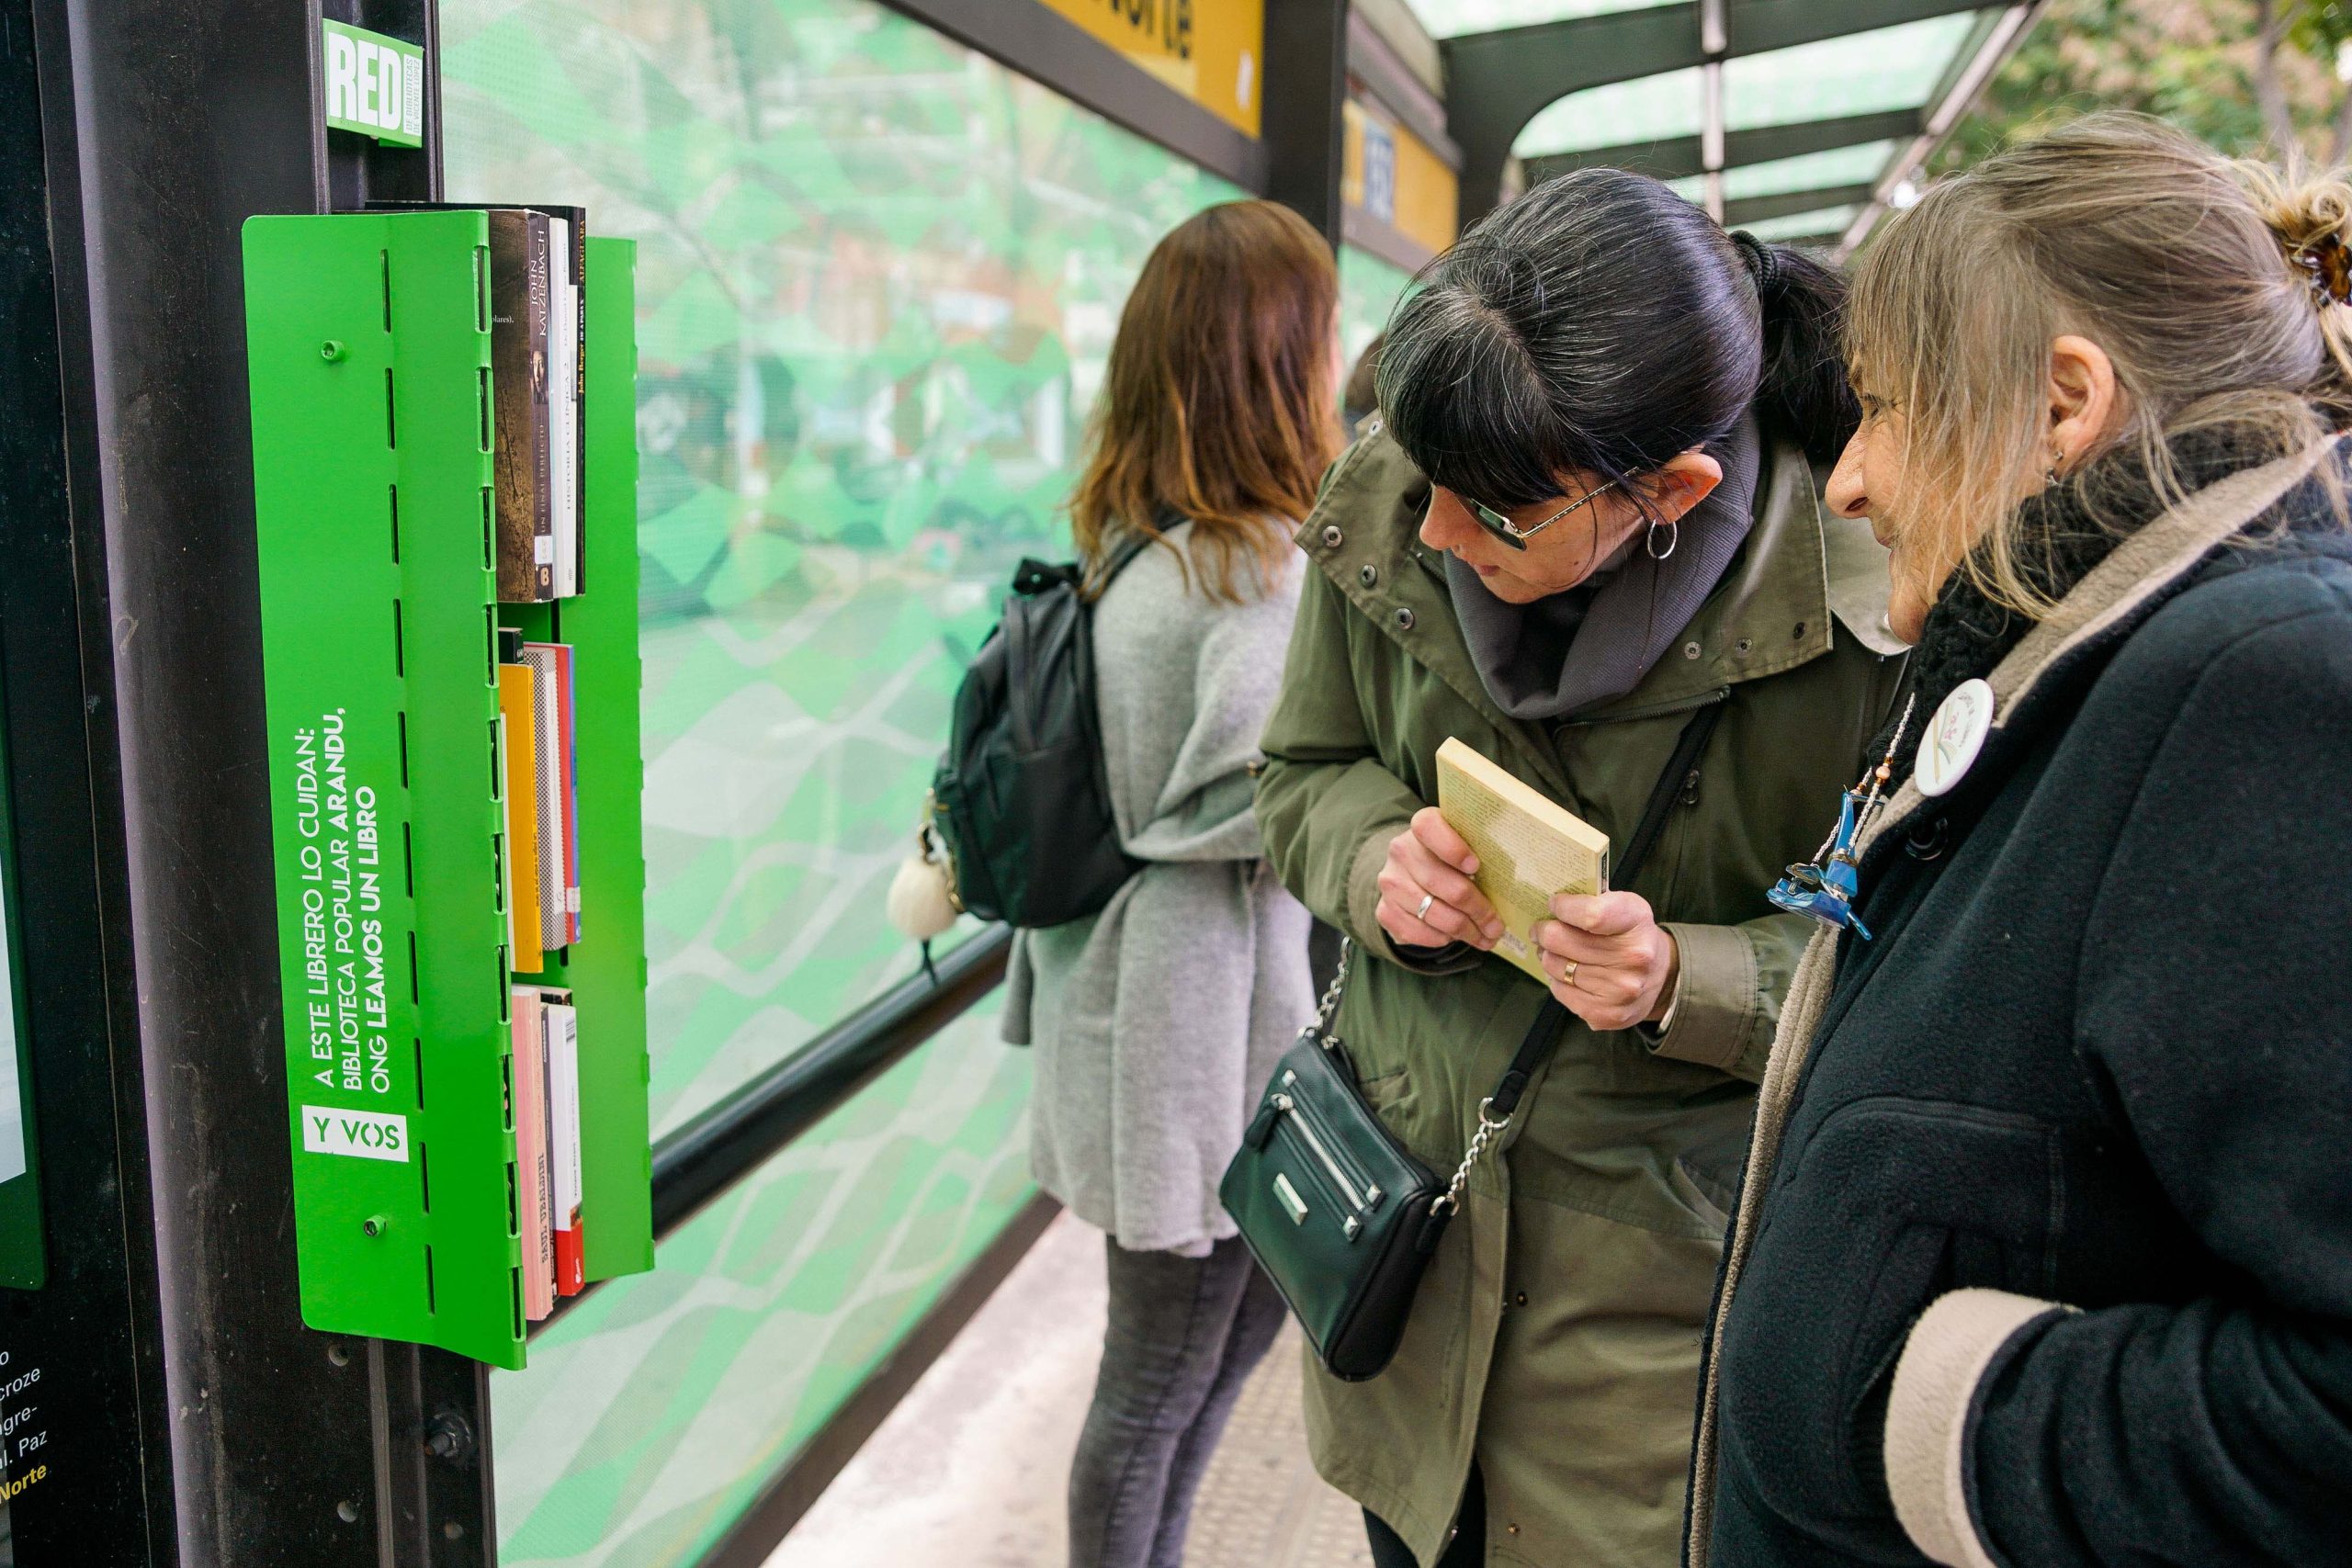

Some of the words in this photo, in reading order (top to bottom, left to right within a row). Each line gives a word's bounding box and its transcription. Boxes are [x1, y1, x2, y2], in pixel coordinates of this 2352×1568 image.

[328, 31, 402, 130] RED
[406, 119, 413, 131] DE
[413, 122, 420, 134] DE
[538, 230, 547, 336] KATZENBACH
[294, 728, 320, 839] CUIDAN:
[322, 707, 350, 832] ARANDU,
[355, 785, 379, 865] LIBRO
[300, 845, 322, 881] LO
[359, 872, 381, 912] UN
[330, 839, 355, 955] POPULAR
[302, 889, 329, 996] LIBRERO
[361, 919, 388, 1029] LEAMOS
[309, 1002, 333, 1061] ESTE
[336, 962, 362, 1091] BIBLIOTECA
[313, 1069, 334, 1089] A
[368, 1035, 390, 1094] ONG
[313, 1116, 331, 1143] Y
[341, 1119, 401, 1150] VOS
[537, 1152, 548, 1224] UBALDINI
[540, 1224, 548, 1264] SAUL
[0, 1406, 38, 1436] gre-
[18, 1430, 48, 1458] Paz
[0, 1465, 47, 1504] Norte
